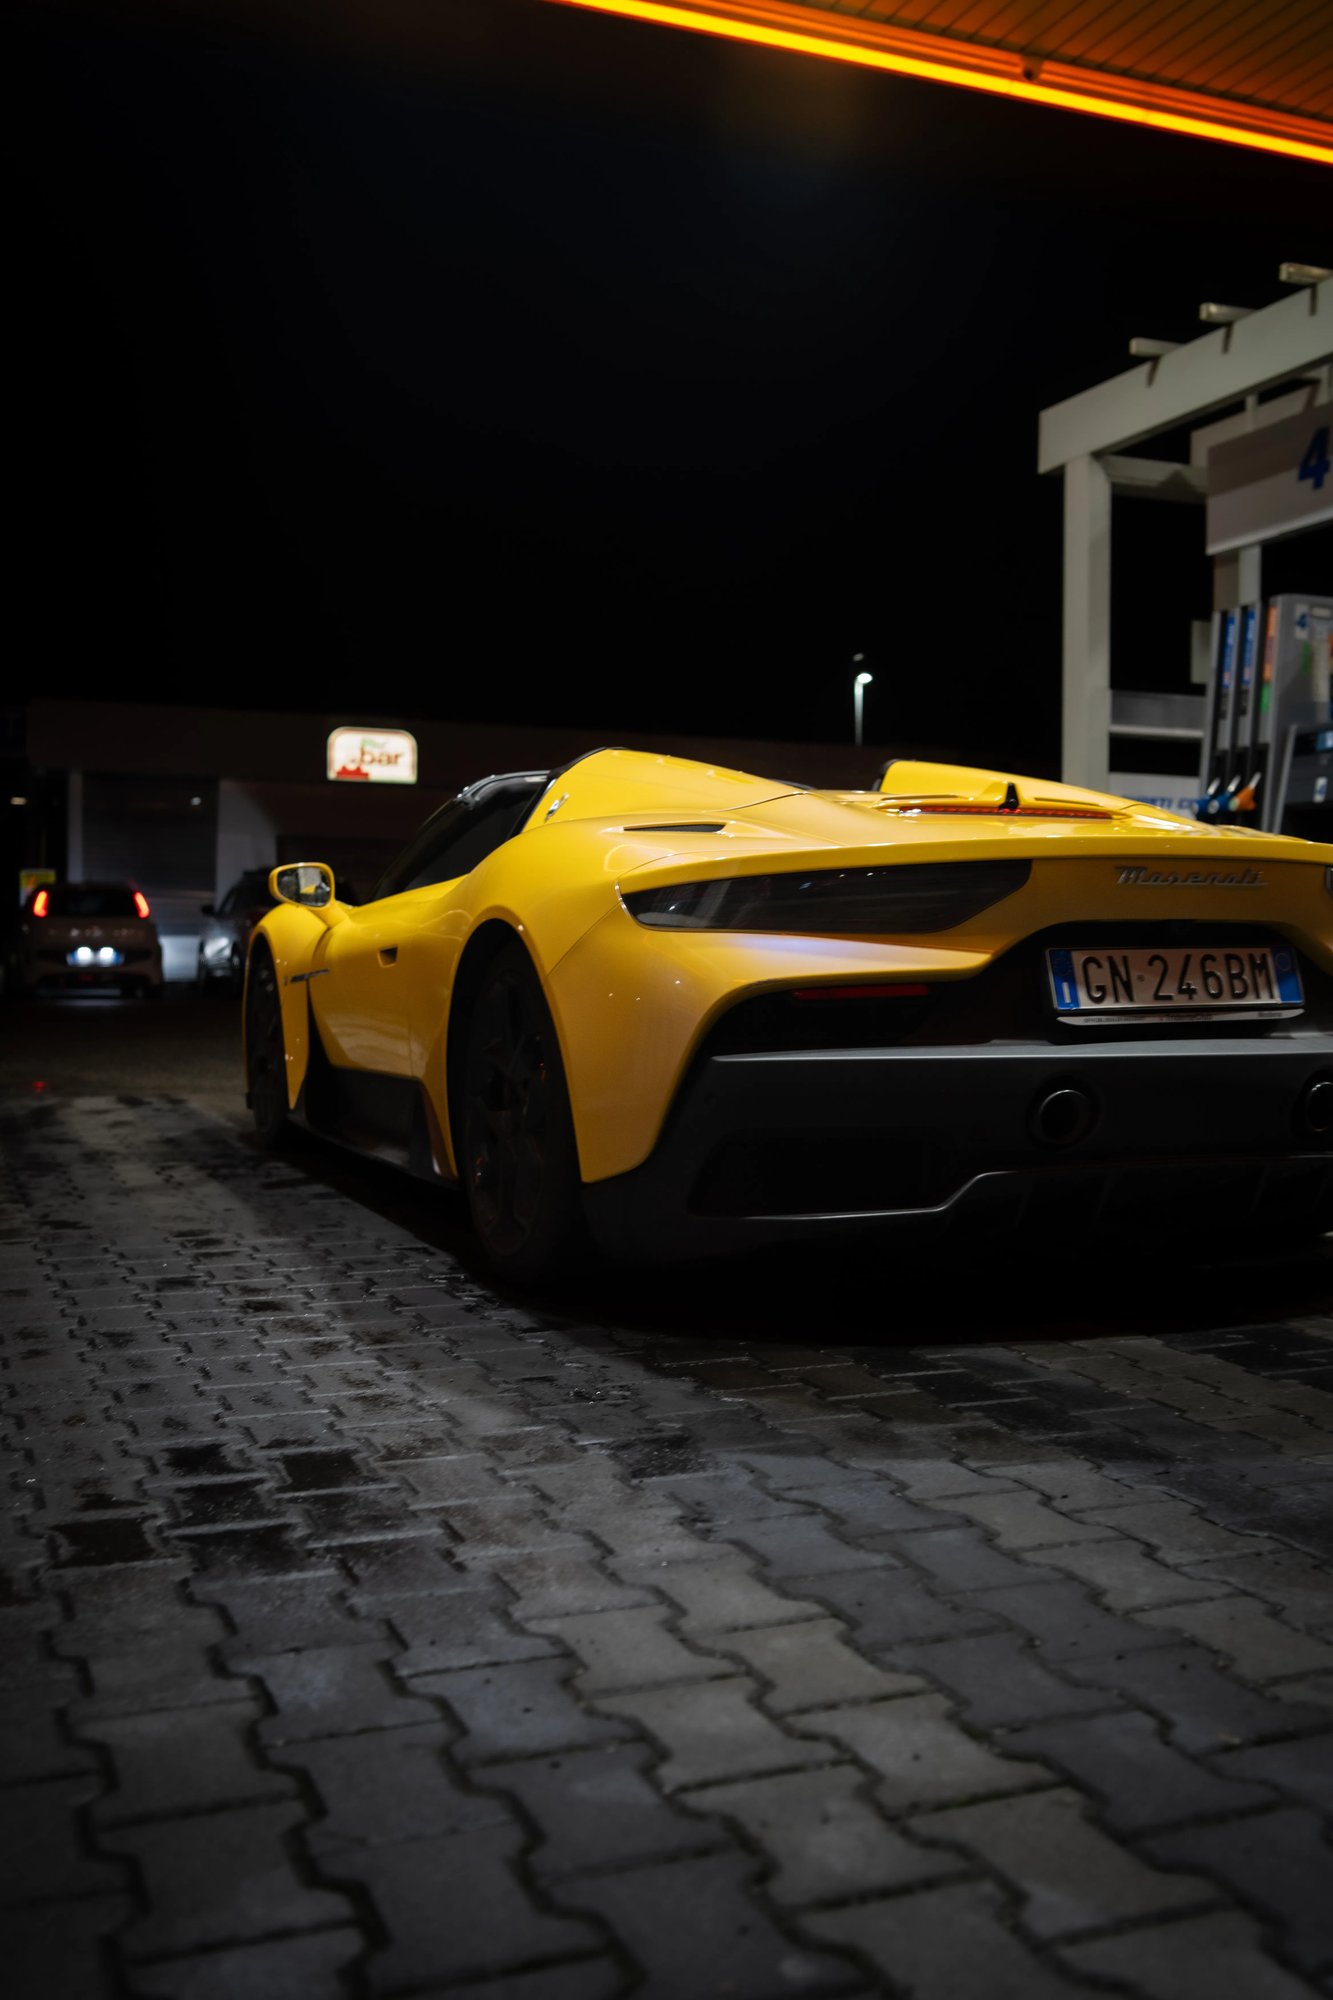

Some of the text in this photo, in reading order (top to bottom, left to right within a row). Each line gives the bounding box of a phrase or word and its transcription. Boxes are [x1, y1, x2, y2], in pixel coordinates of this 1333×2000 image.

[1299, 426, 1329, 489] 4
[360, 745, 403, 766] bar
[1115, 865, 1269, 888] Maserati
[1082, 953, 1275, 1004] GN 246BM
